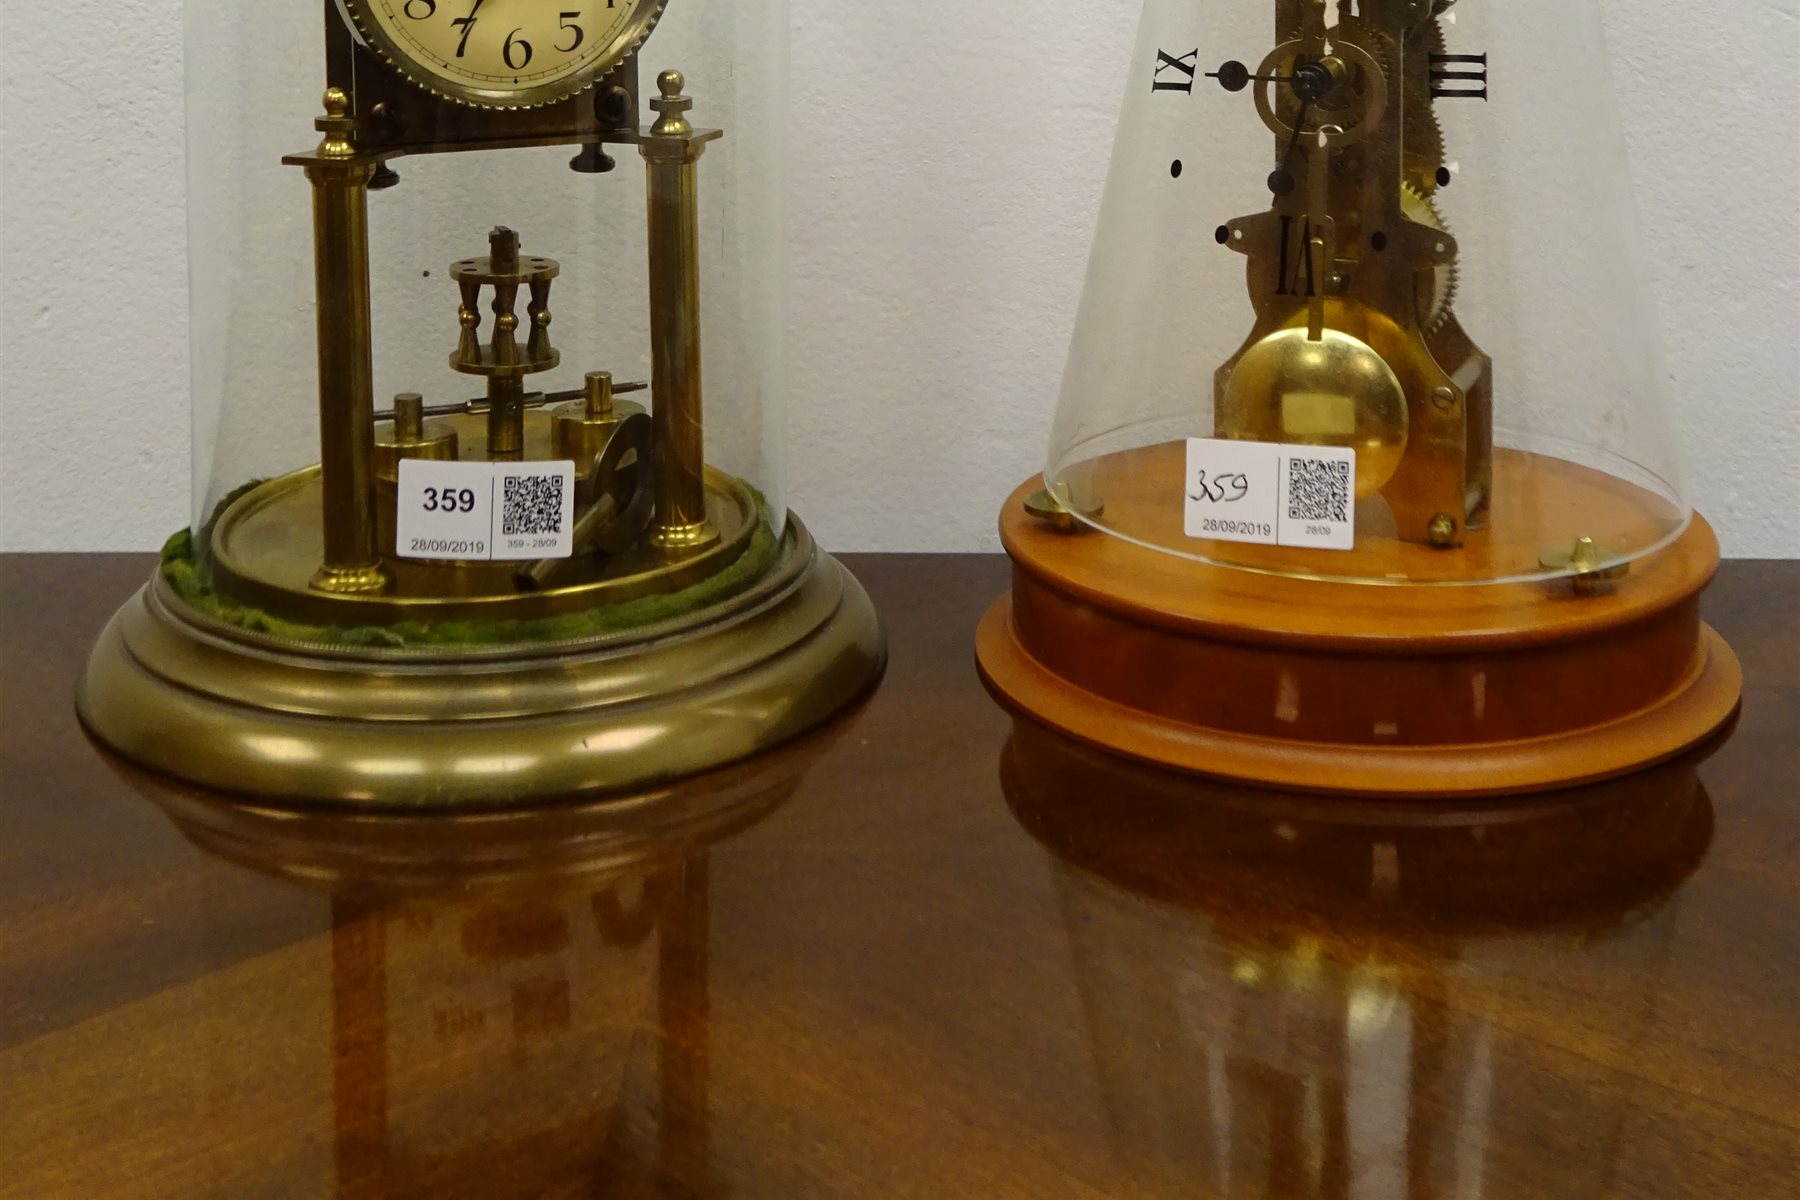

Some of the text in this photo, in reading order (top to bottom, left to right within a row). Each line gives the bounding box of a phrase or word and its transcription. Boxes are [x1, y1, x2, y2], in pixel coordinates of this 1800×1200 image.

[450, 17, 478, 58] 7
[554, 11, 584, 52] 5
[502, 28, 533, 70] 6
[1152, 47, 1198, 96] IX
[1429, 52, 1488, 102] III
[423, 487, 475, 513] 359
[1188, 469, 1248, 503] 359
[507, 540, 525, 548] 359
[532, 538, 557, 549] 28/09
[1202, 518, 1271, 536] 28/09/2019
[1305, 525, 1331, 536] 28/09
[411, 538, 485, 553] 28/09/2019
